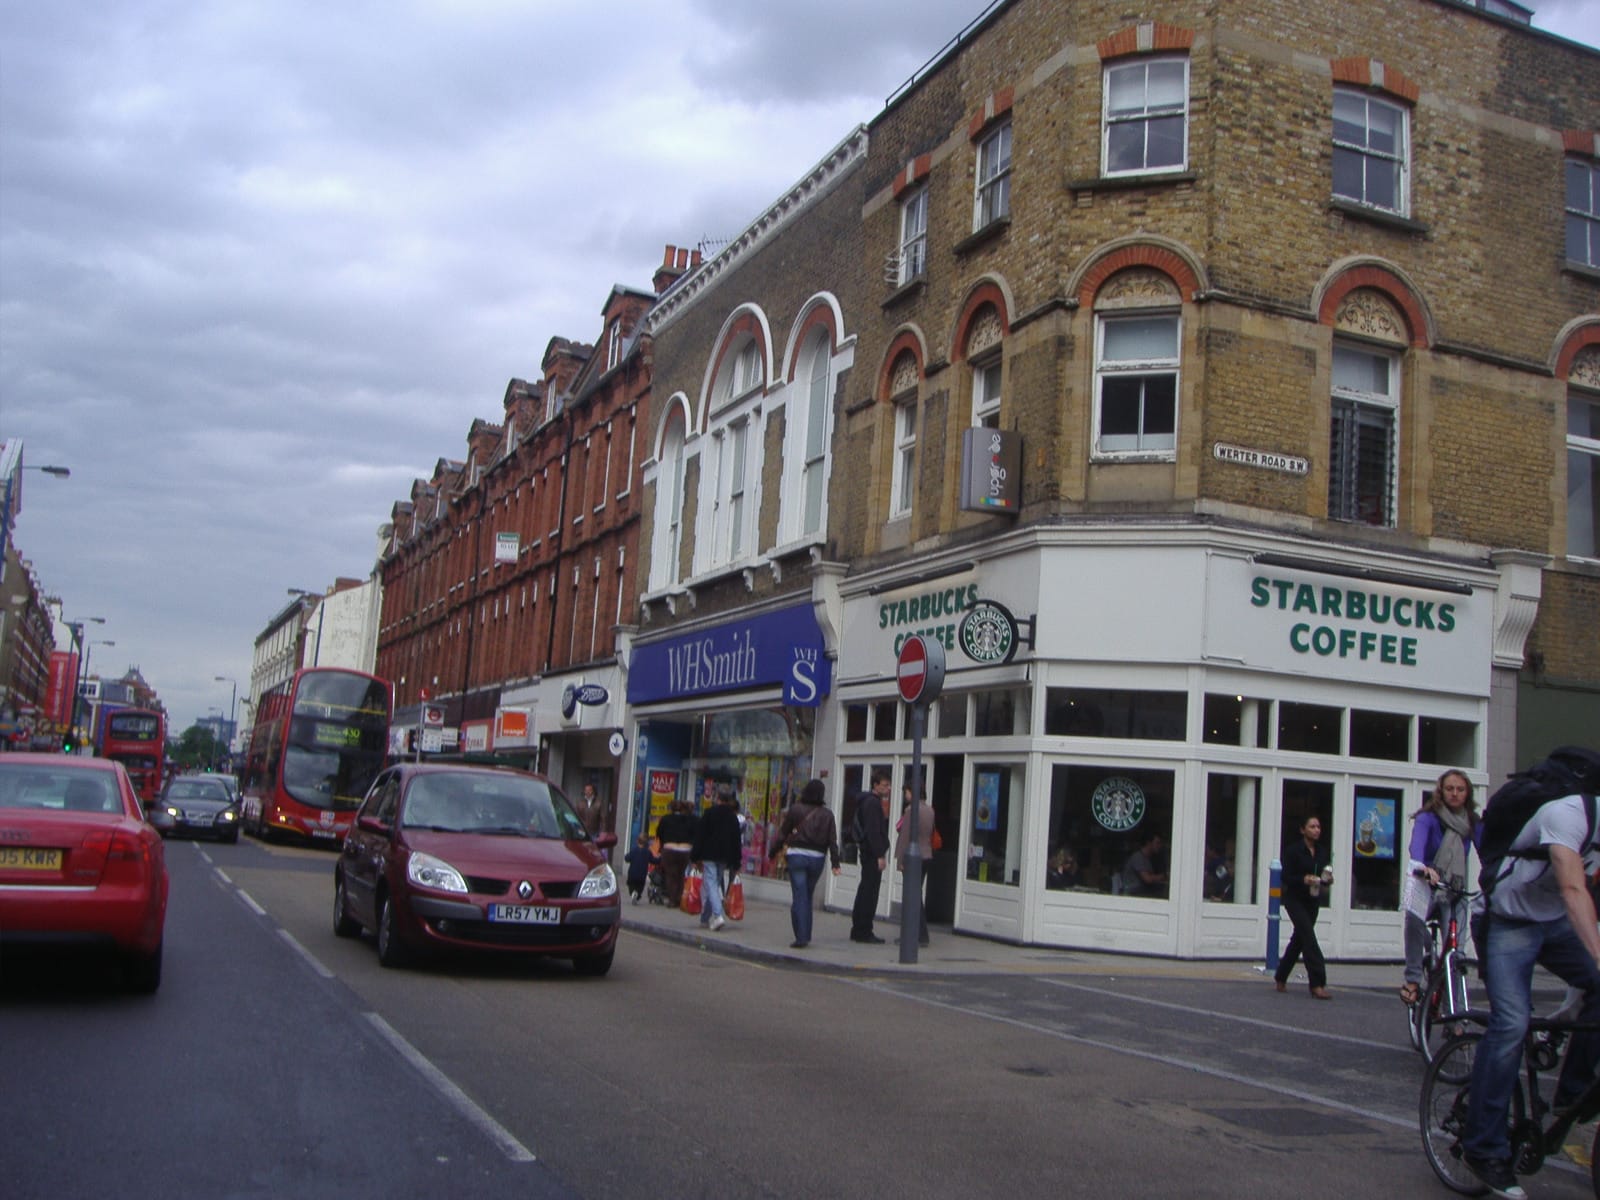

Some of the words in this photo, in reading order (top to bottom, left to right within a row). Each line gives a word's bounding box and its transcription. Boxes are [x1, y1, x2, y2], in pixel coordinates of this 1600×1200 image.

[1219, 447, 1258, 463] WERTER
[879, 583, 978, 629] STARBUCKS
[1250, 576, 1456, 633] STARBUCKS
[966, 611, 1010, 637] STARBUCKS
[794, 647, 817, 662] WH
[968, 643, 1004, 661] COFFEE
[1290, 623, 1418, 666] COFFEE
[668, 629, 756, 694] WHSmith
[790, 660, 817, 702] S
[1095, 778, 1143, 805] STARBUCKS
[1099, 812, 1136, 829] COFFEE
[23, 849, 57, 866] KWR
[497, 906, 530, 920] LR57
[535, 908, 558, 921] YMJ
